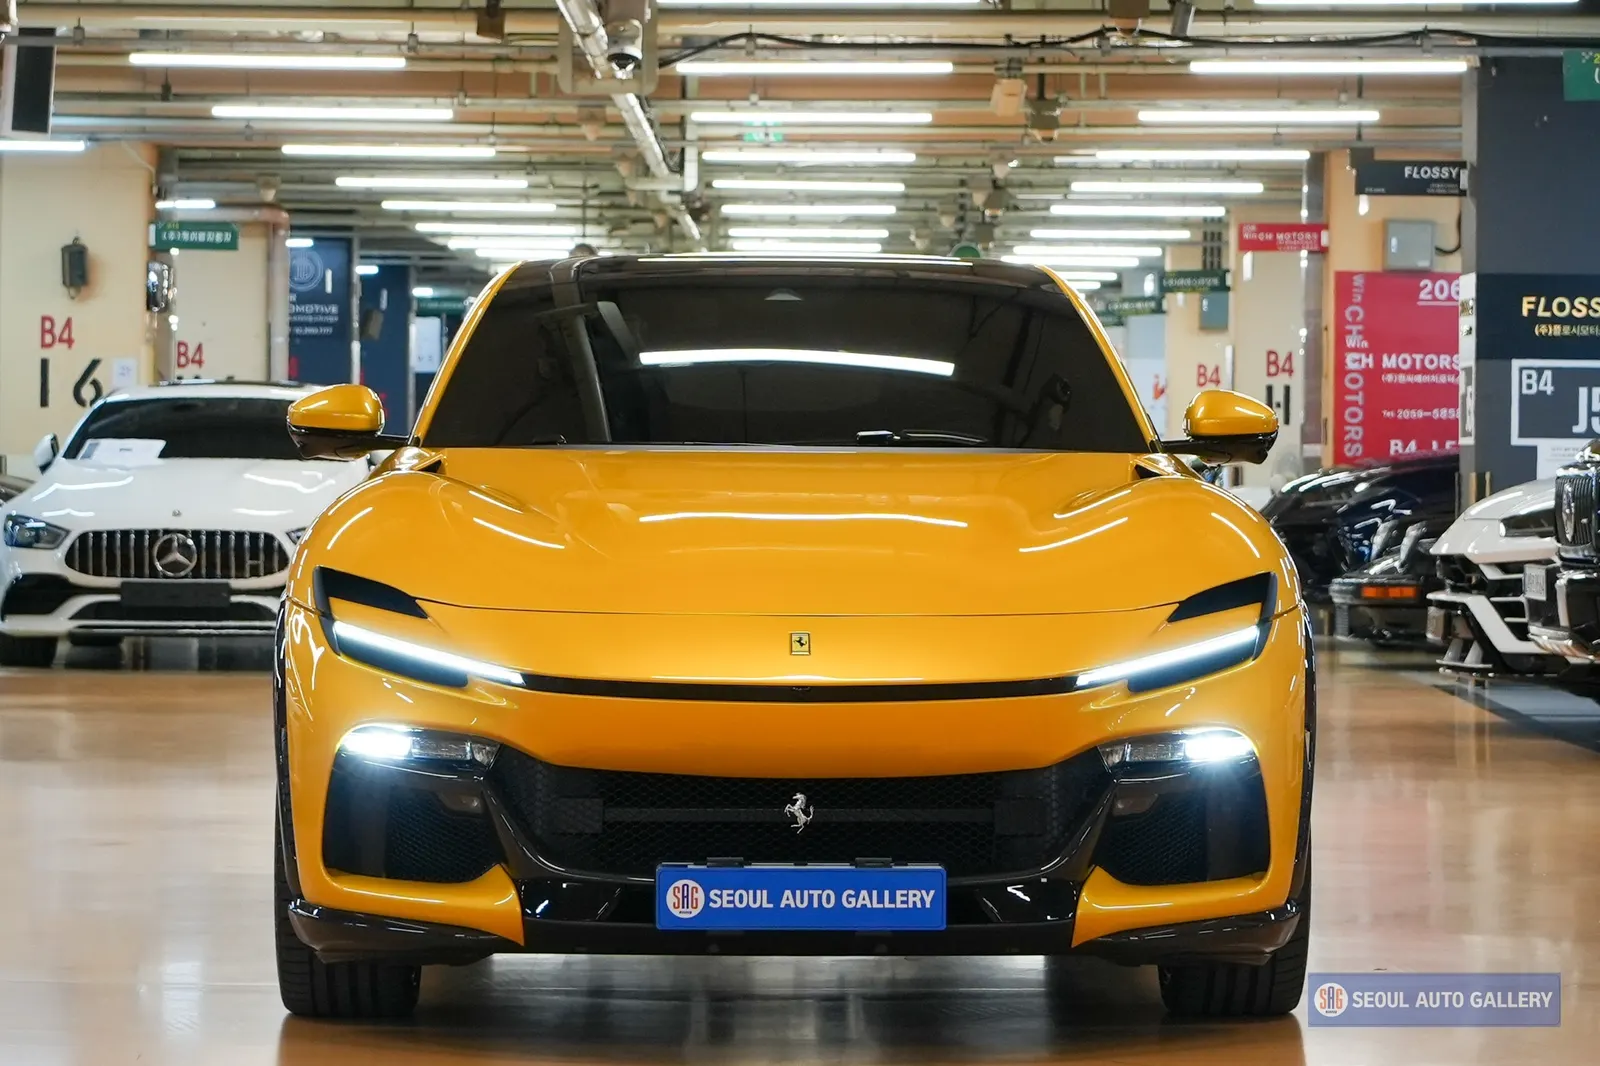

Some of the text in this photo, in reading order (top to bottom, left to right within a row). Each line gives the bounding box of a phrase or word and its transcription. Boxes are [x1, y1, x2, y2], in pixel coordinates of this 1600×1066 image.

[1404, 166, 1459, 179] FLOSSY
[40, 315, 75, 349] B4
[1534, 323, 1600, 337] (주)플로시모터
[176, 341, 205, 369] B4
[1266, 350, 1294, 377] B4
[1381, 353, 1460, 371] MOTORS
[1196, 364, 1221, 388] B4
[1521, 369, 1554, 396] B4
[672, 883, 935, 910] SAG SEOUL AUTO GALLERY
